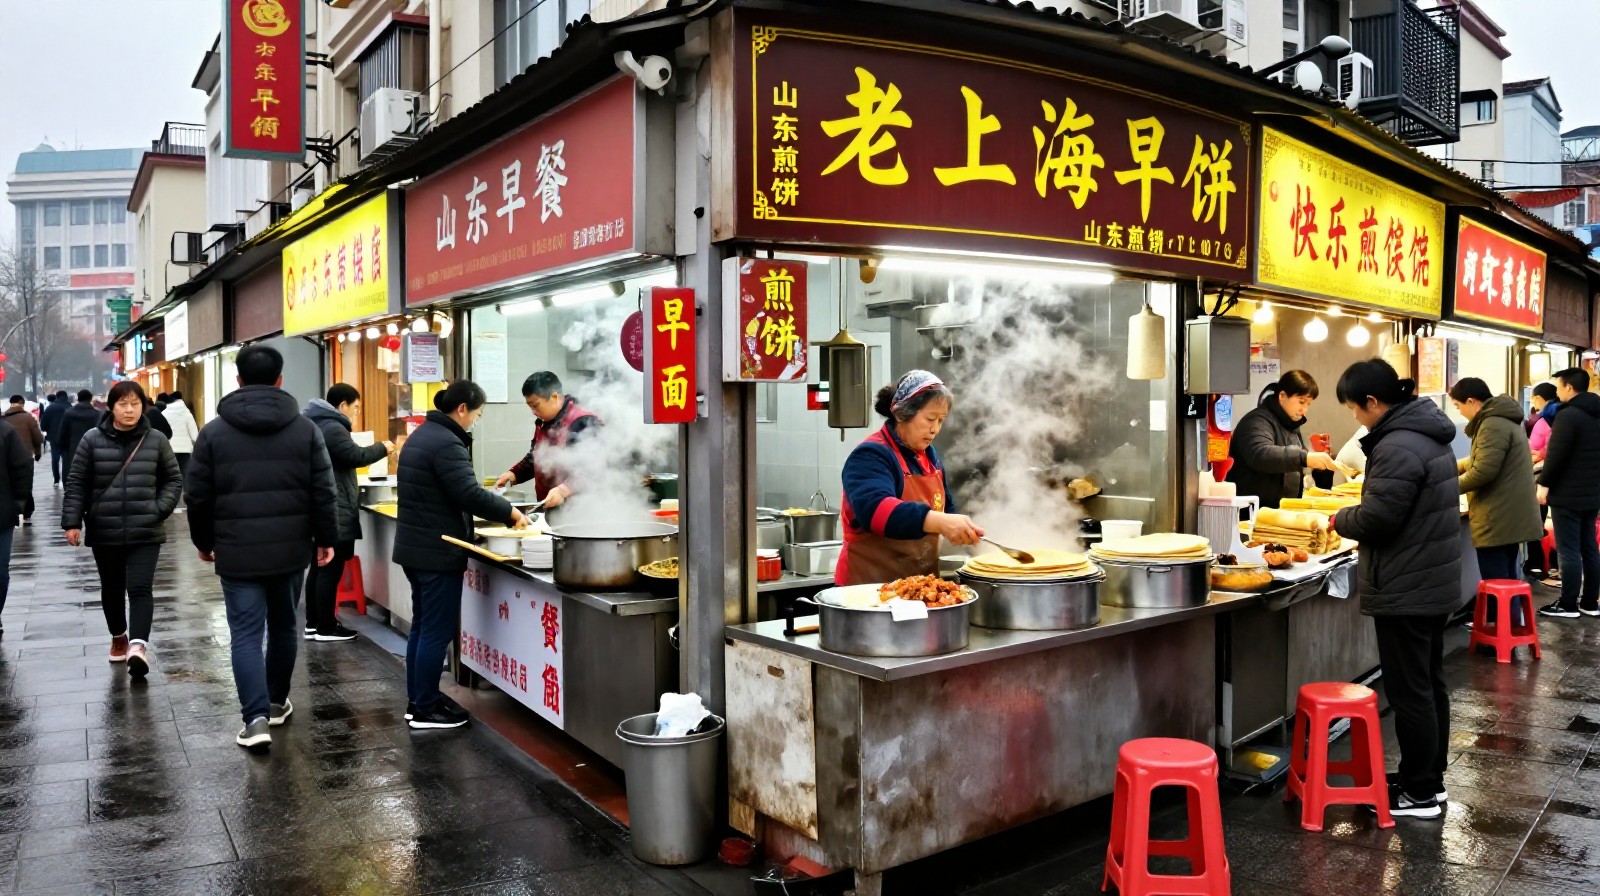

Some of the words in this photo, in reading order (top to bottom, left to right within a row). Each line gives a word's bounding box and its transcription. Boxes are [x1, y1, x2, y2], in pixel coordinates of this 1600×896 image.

[436, 139, 569, 252] 山东早餐
[771, 81, 800, 206] 山东煎饼
[820, 66, 1237, 235] 老上海早饼
[657, 298, 691, 410] 早面
[760, 267, 801, 362] 煎饼
